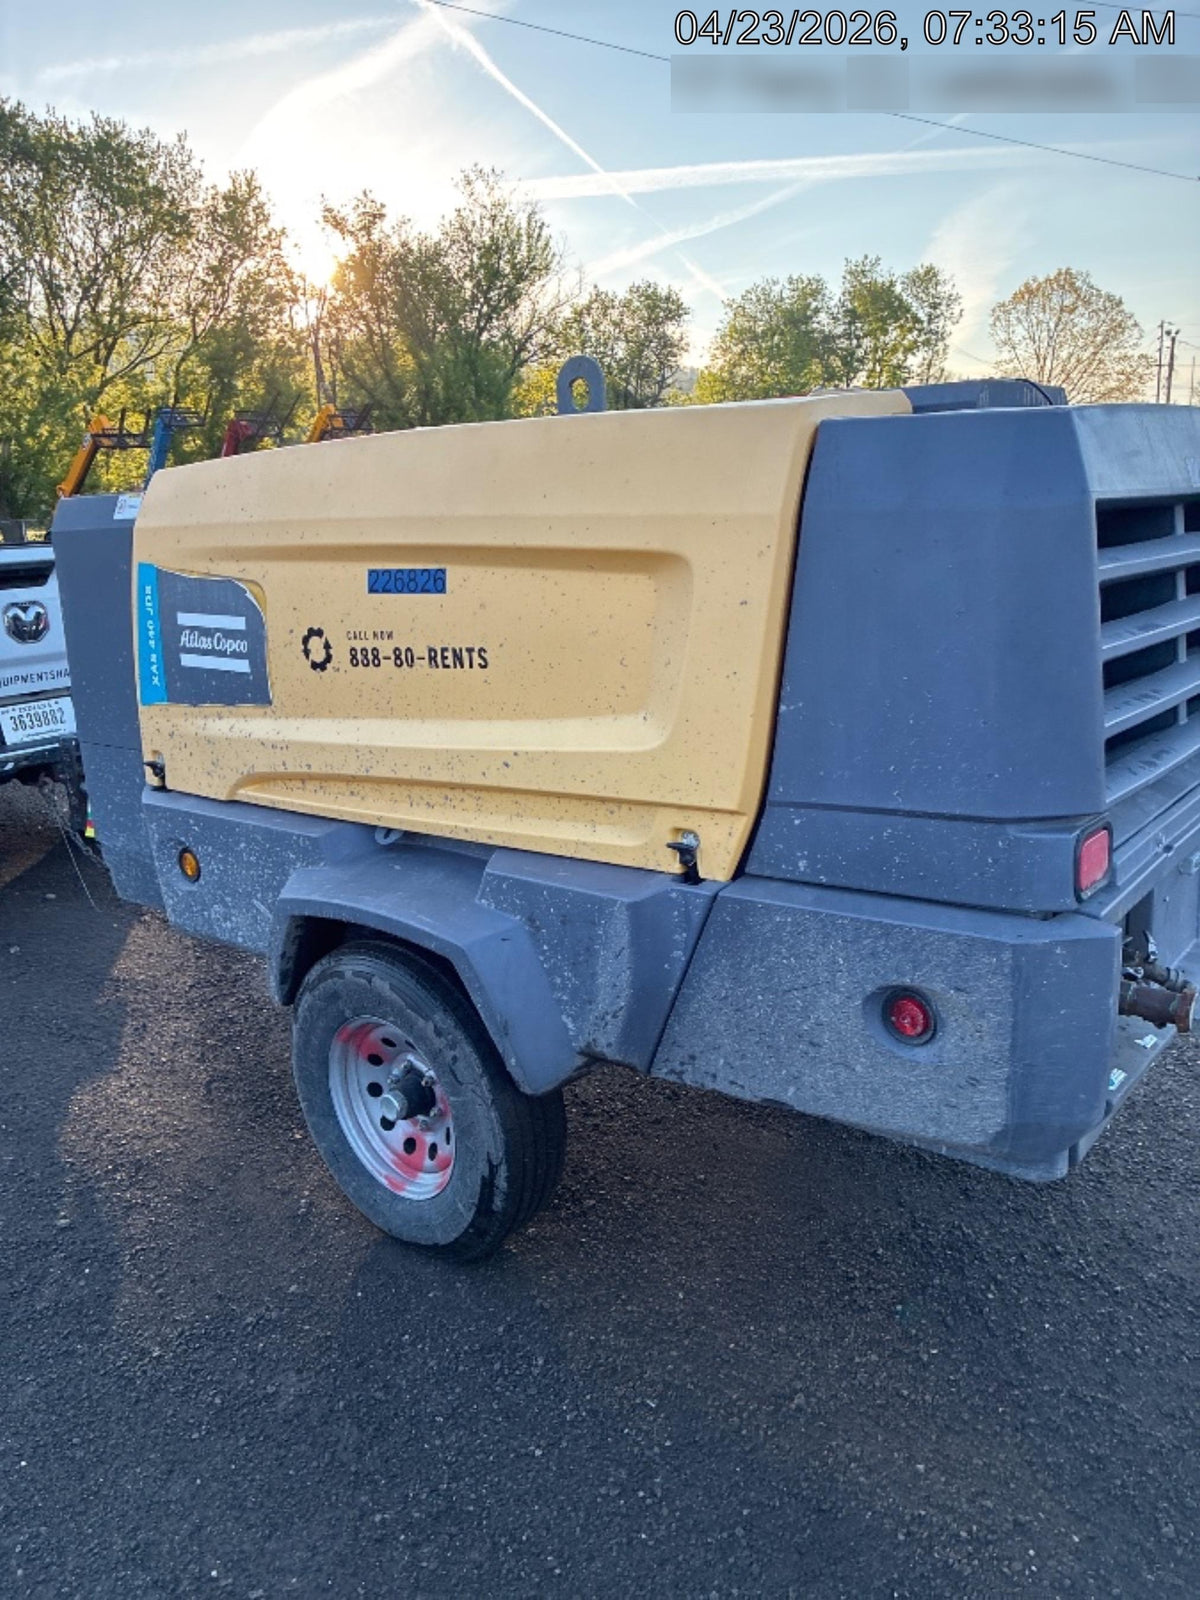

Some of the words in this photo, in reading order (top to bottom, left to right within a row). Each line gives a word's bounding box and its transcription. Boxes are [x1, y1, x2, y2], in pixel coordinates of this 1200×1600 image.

[368, 569, 446, 593] 226826
[179, 629, 212, 649] Atlas
[213, 632, 248, 655] Copco
[346, 630, 370, 641] CALL
[373, 630, 394, 641] NOW
[350, 647, 489, 669] 888-80-RENTS
[0, 668, 70, 688] UIPMENTSHA
[10, 707, 67, 732] 3639882
